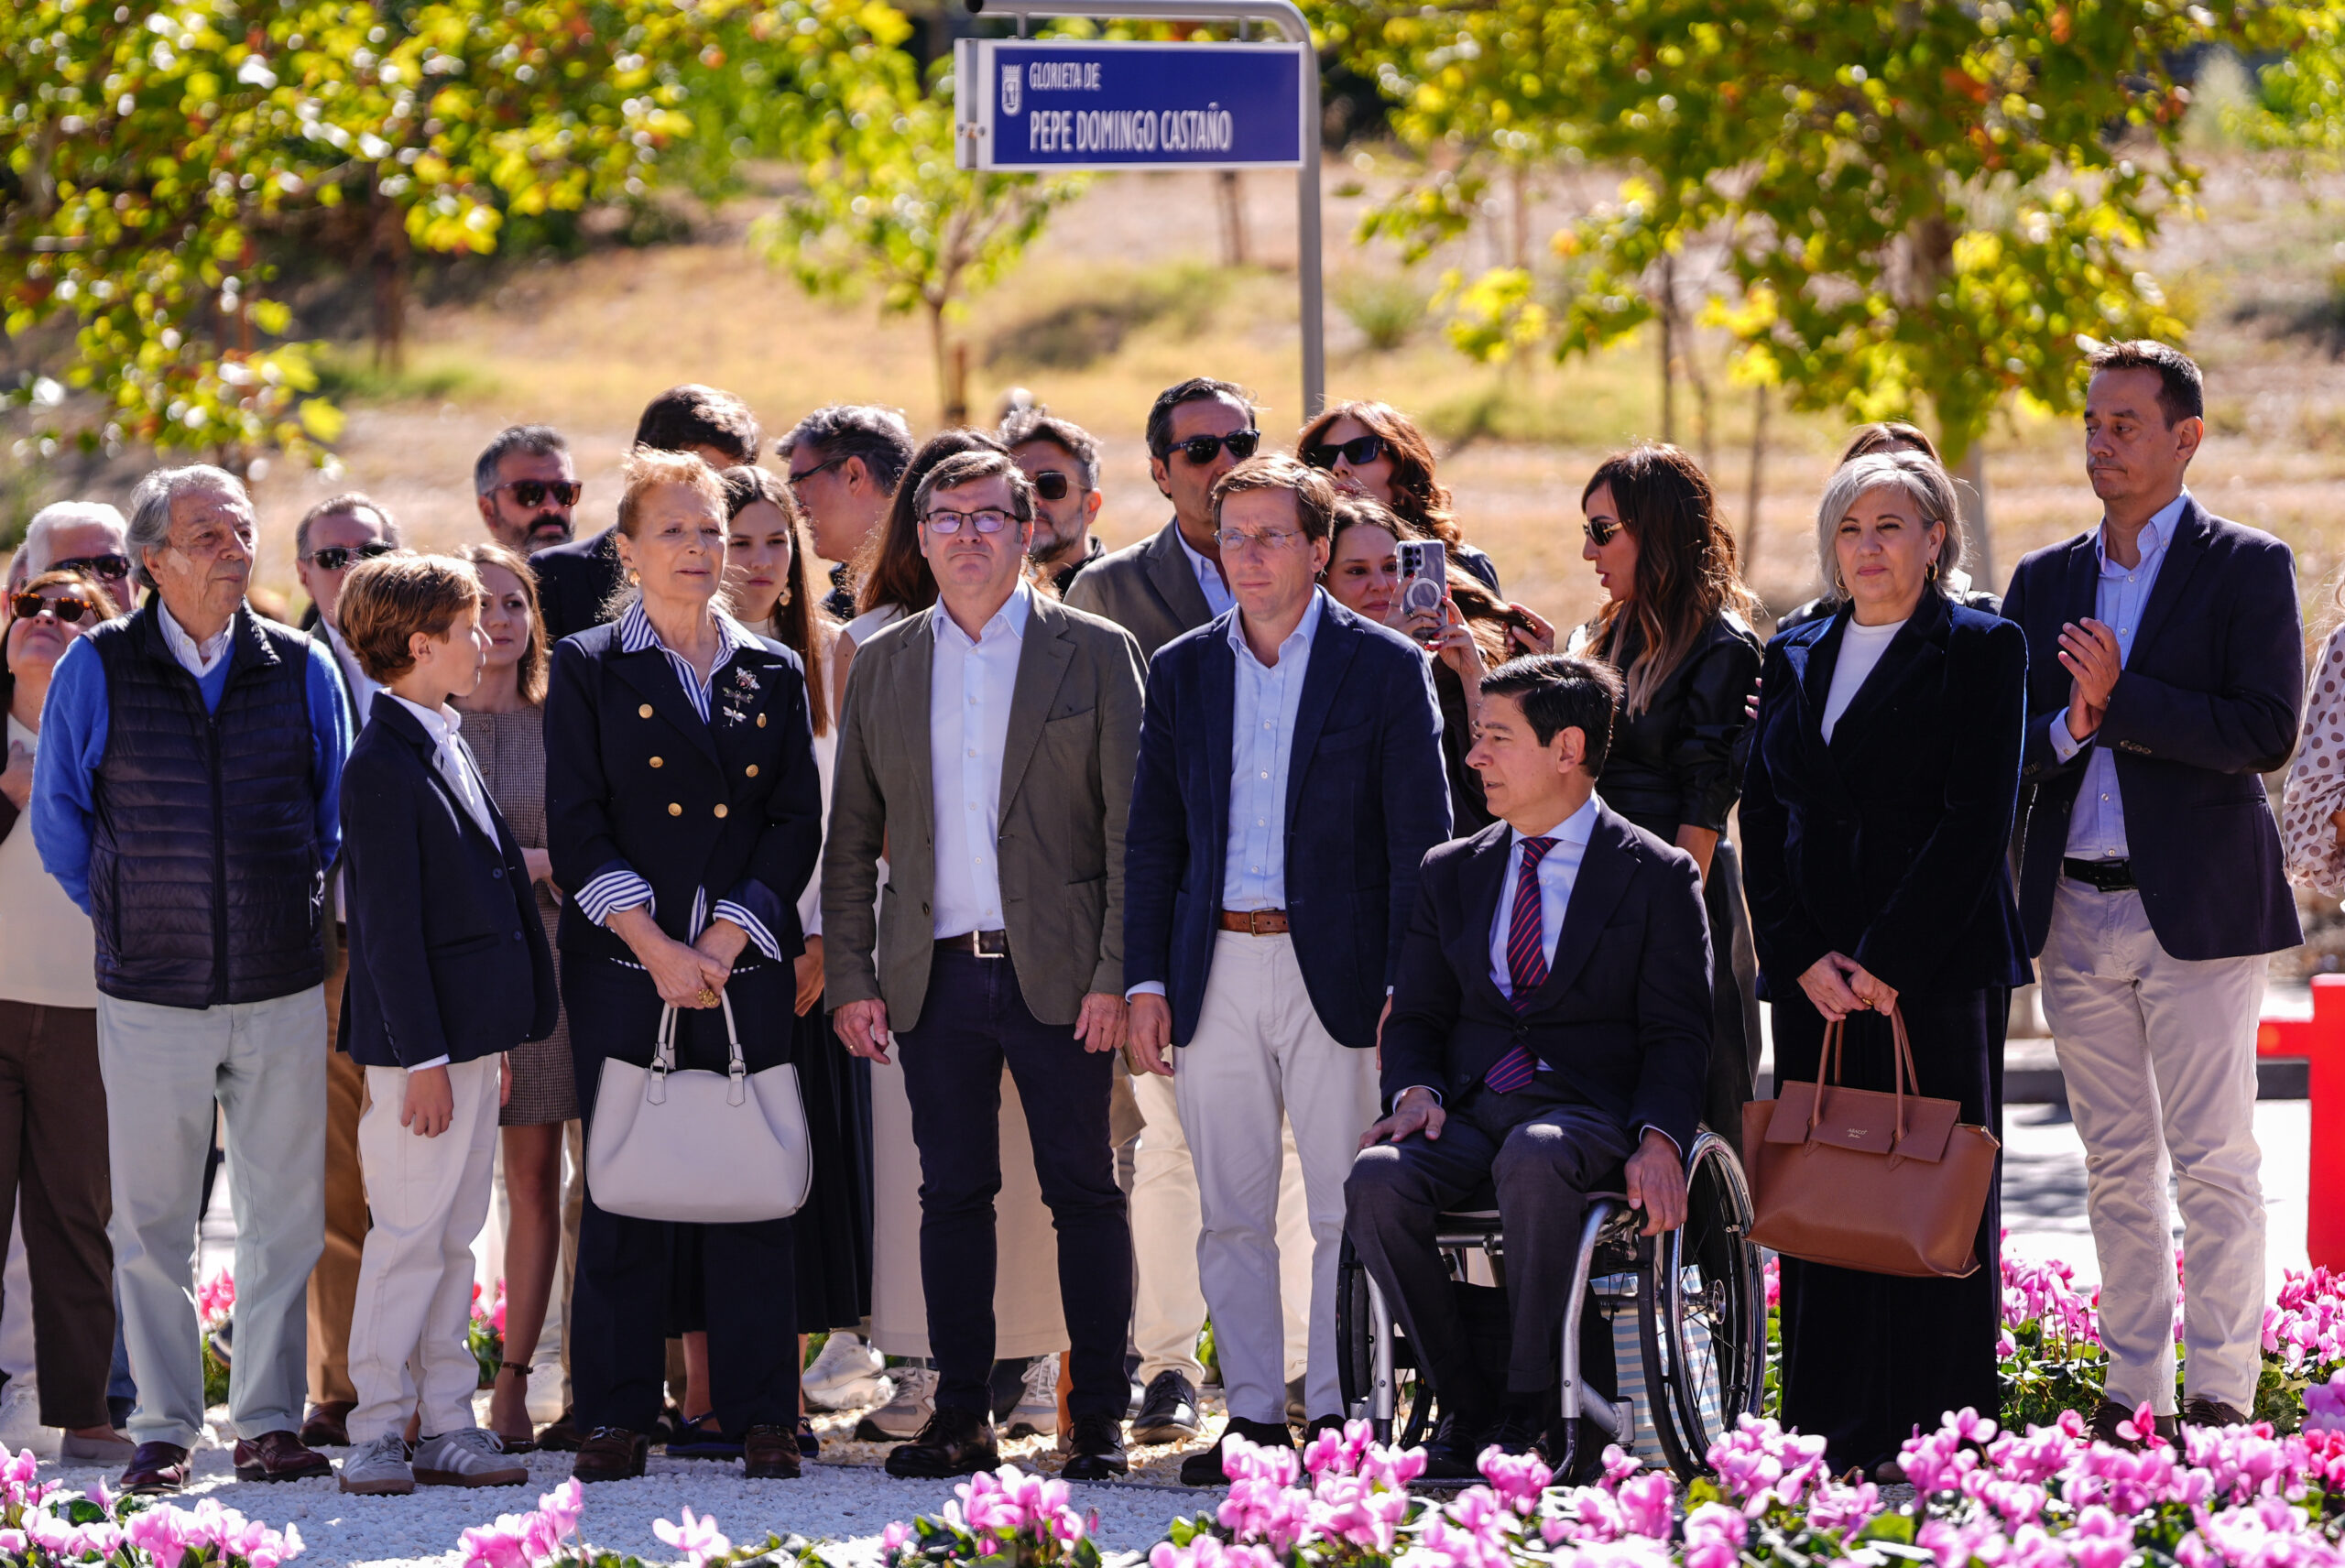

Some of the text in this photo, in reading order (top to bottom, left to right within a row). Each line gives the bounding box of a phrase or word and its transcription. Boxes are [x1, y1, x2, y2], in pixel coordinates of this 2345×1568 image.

[1029, 62, 1101, 91] GLORIETA DE
[1030, 102, 1233, 152] PEPE DOMINGO CASTAÑO
